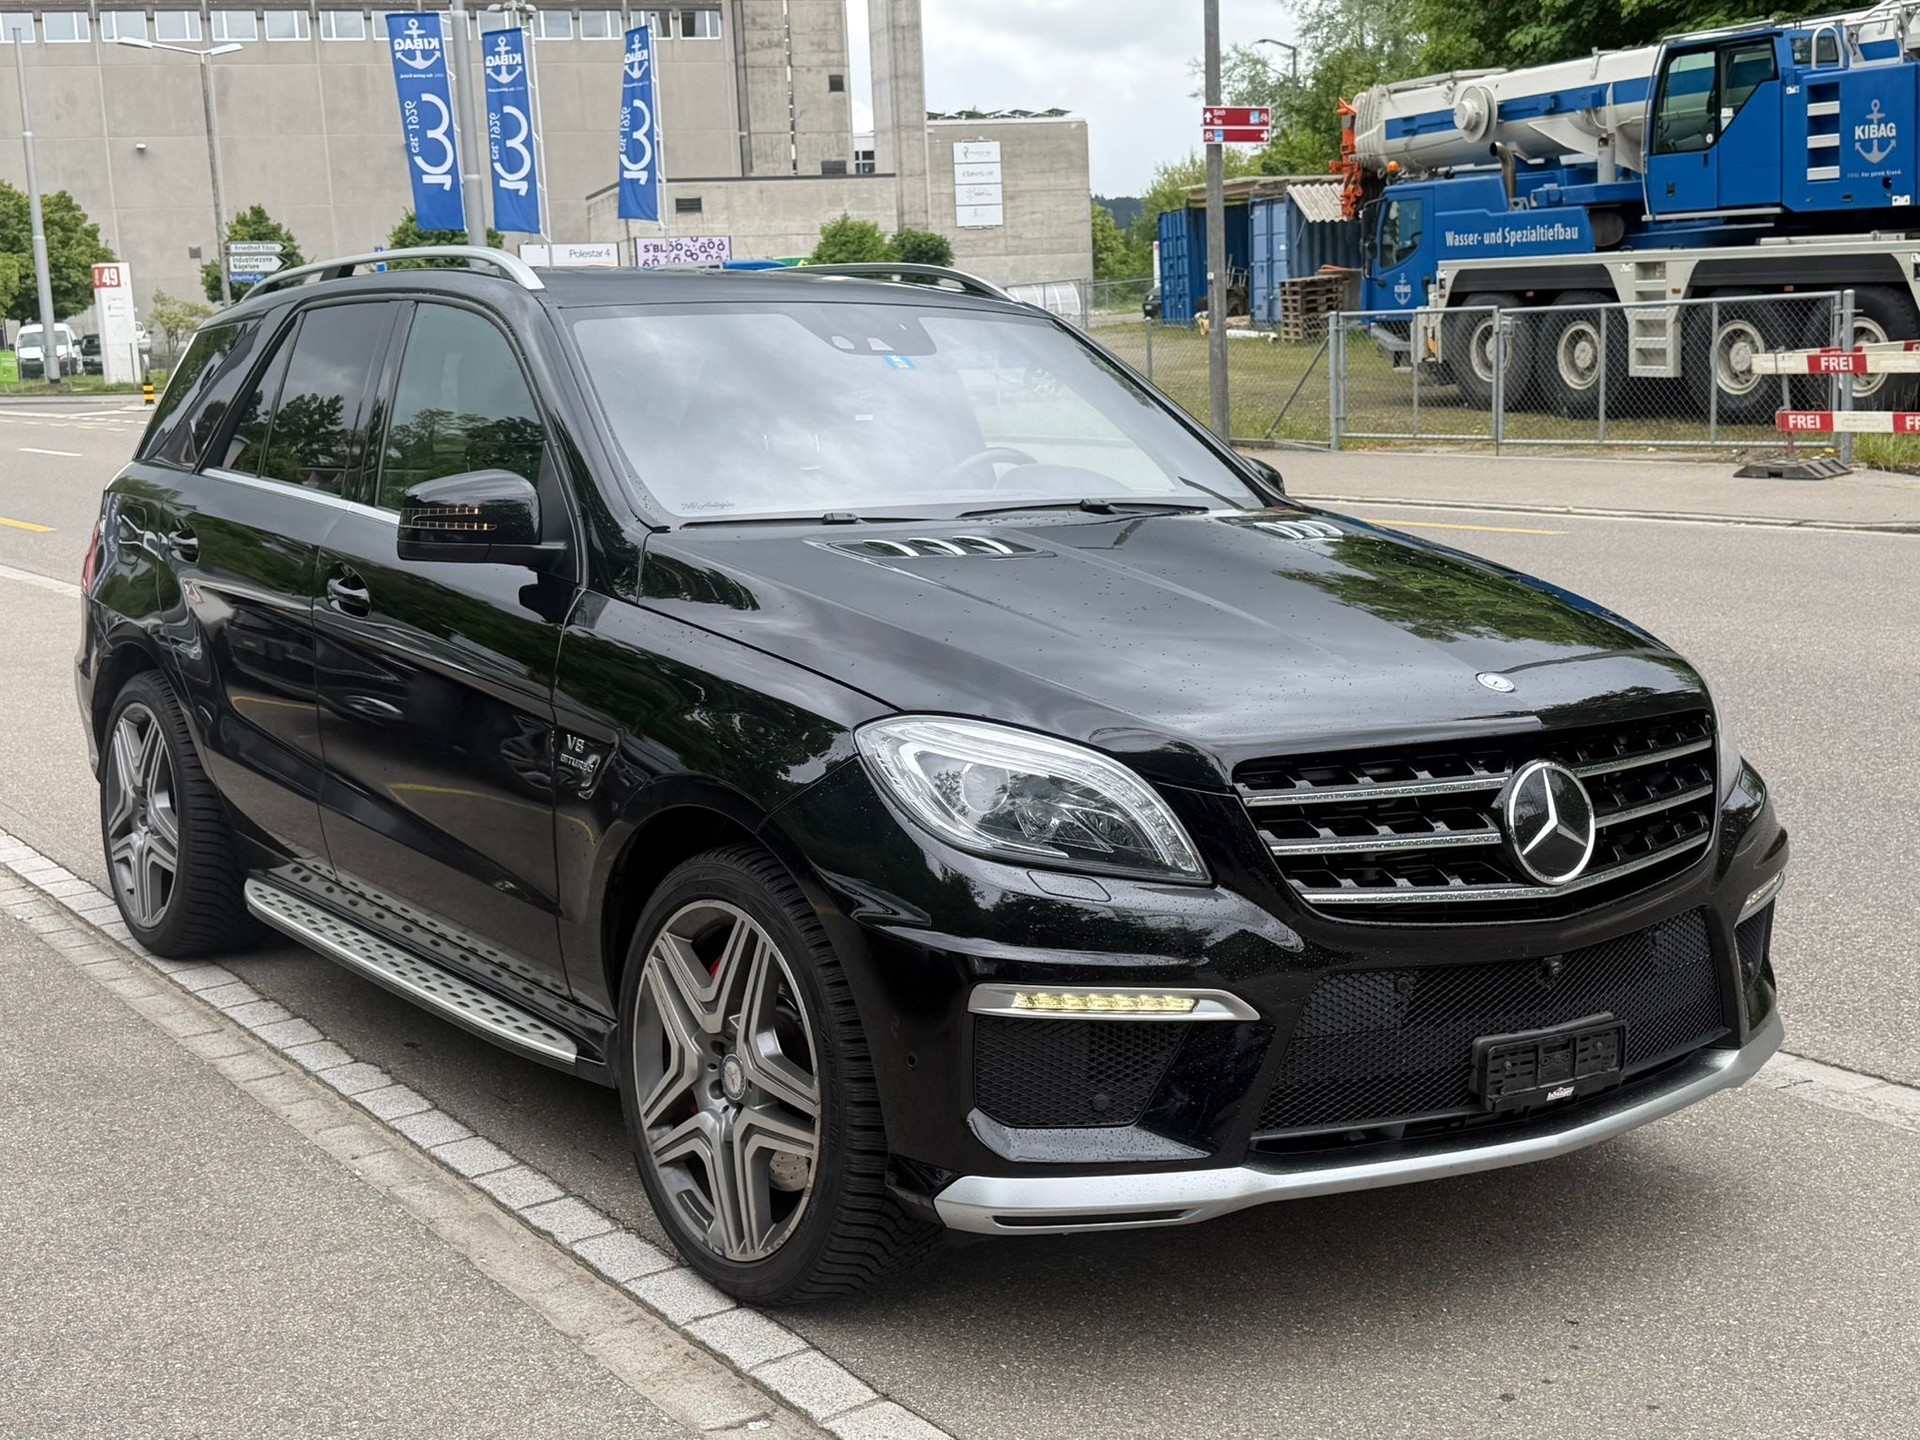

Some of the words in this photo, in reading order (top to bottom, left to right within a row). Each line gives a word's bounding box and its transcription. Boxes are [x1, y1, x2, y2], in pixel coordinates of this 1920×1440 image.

[1855, 123, 1897, 140] KIBAG
[1445, 230, 1482, 247] Wasser-
[1483, 227, 1503, 245] und
[1504, 223, 1579, 247] Spezialtiefbau
[569, 249, 603, 259] Polestar
[604, 249, 611, 257] 4
[101, 268, 119, 286] 49
[1820, 356, 1854, 371] FREI
[1788, 415, 1821, 429] FREI
